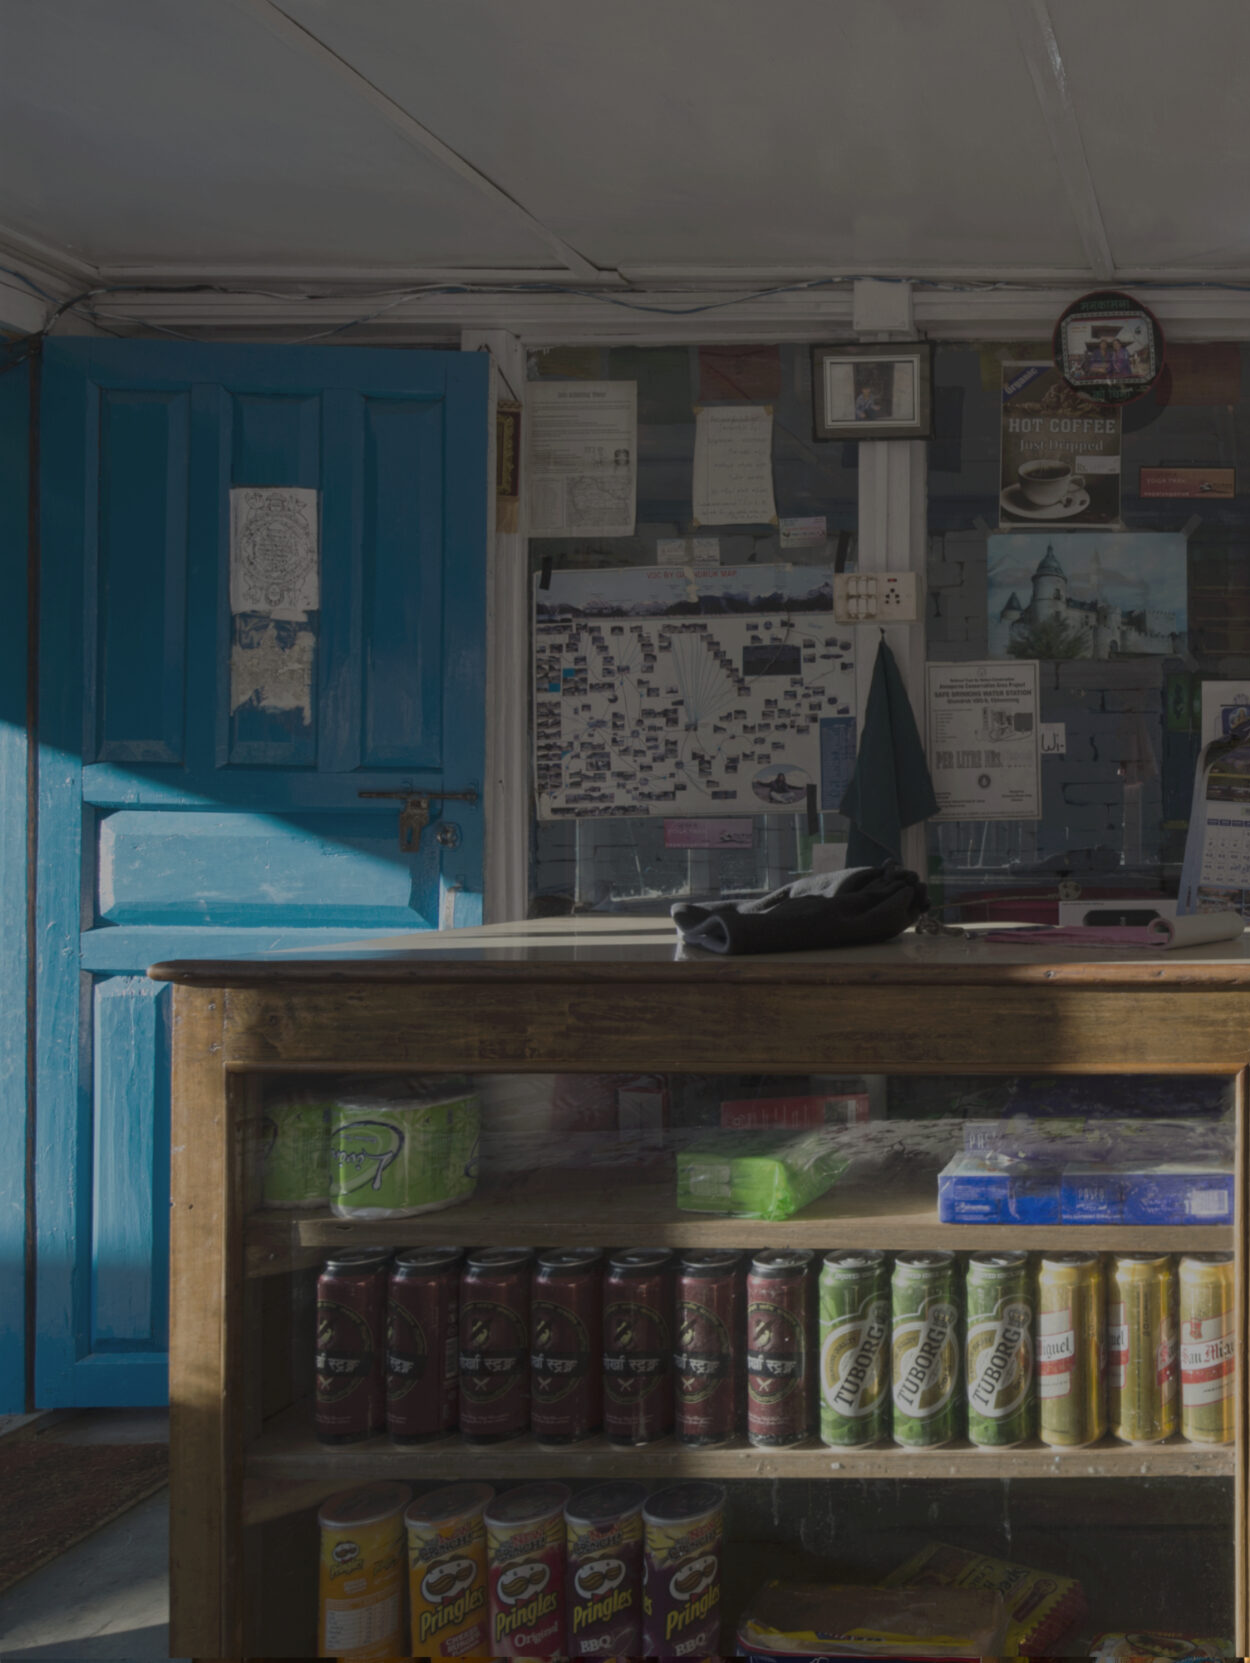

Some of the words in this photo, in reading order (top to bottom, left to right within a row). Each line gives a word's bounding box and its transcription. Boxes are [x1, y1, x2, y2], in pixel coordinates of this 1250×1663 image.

[1004, 368, 1039, 395] Organic
[1009, 418, 1043, 433] HOT
[1050, 418, 1116, 433] COFFEE
[1020, 439, 1046, 453] Just
[1048, 439, 1104, 454] Dripped
[952, 690, 981, 698] DRINKING
[983, 689, 1004, 697] WATER
[1006, 689, 1032, 697] STATION
[936, 751, 953, 769] PER
[1041, 1340, 1071, 1360] iguel
[833, 1324, 886, 1407] TUBORG
[896, 1325, 948, 1406] TUBORG
[972, 1327, 1023, 1406] TUBORG
[420, 1586, 487, 1642] Pringles
[495, 1591, 559, 1643] Pringles
[572, 1588, 633, 1634] Pringles
[665, 1584, 721, 1641] Pringles
[514, 1620, 559, 1648] Original
[580, 1632, 612, 1654] BBQ
[675, 1633, 706, 1656] BBQ
